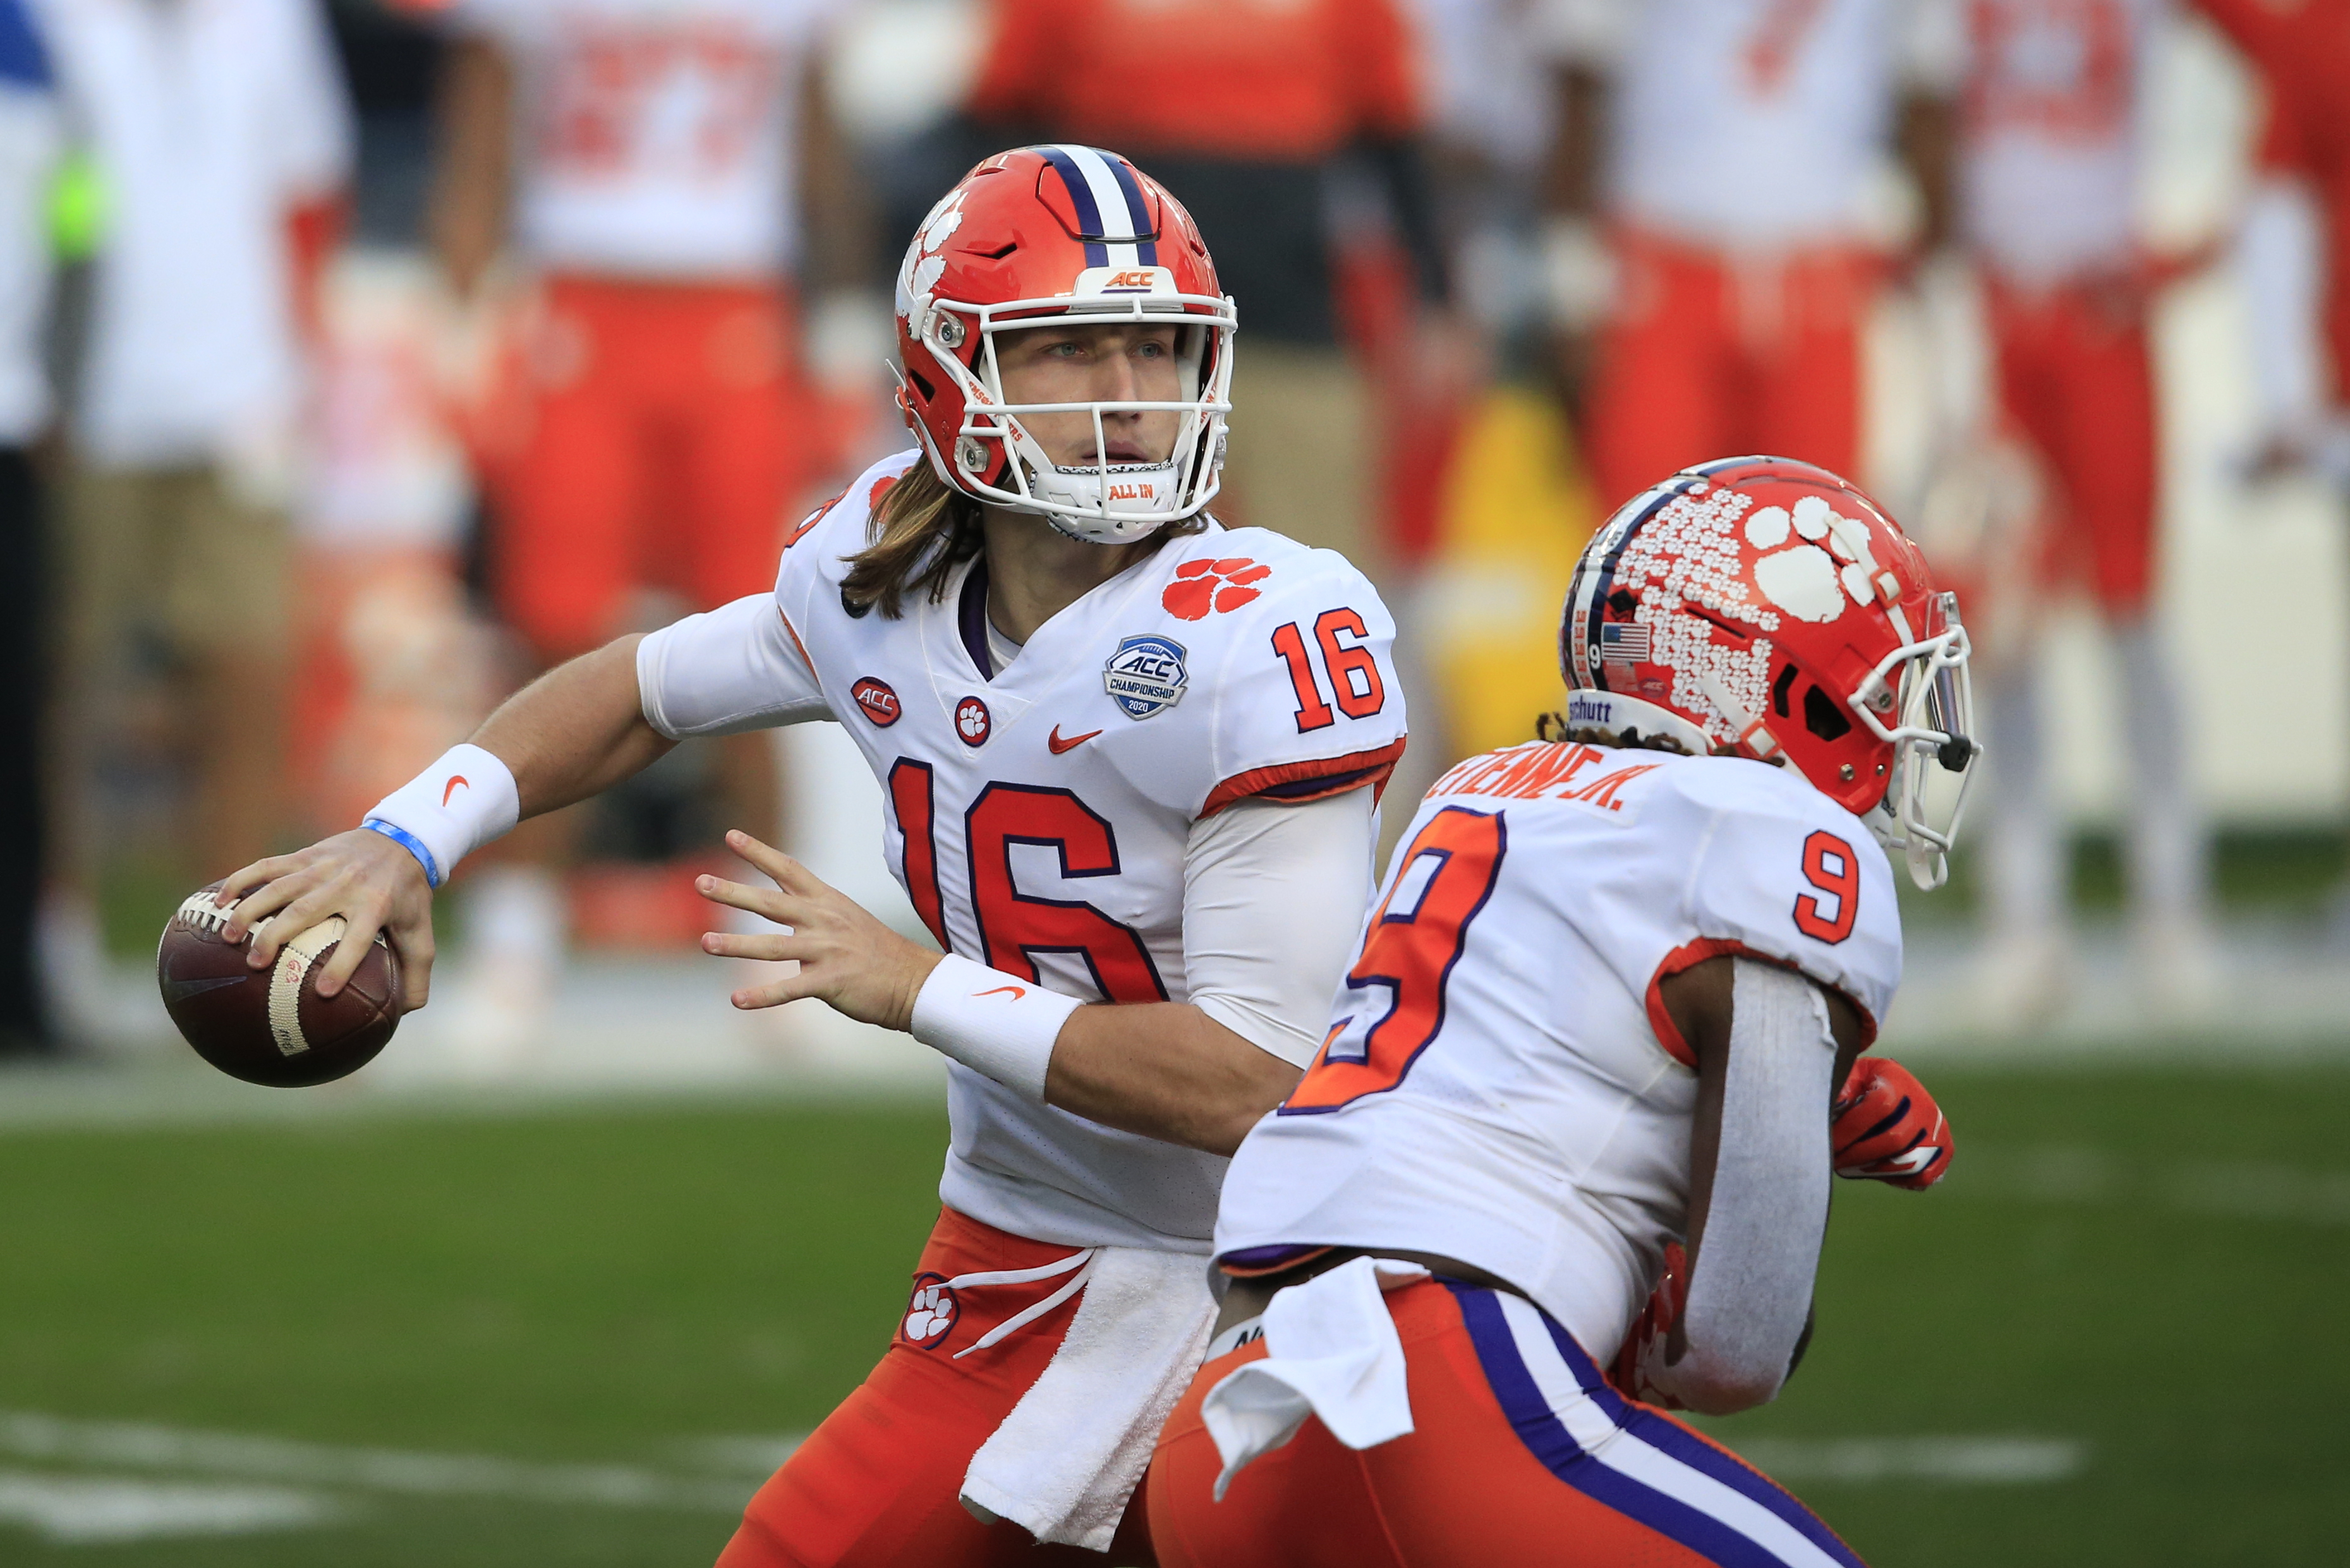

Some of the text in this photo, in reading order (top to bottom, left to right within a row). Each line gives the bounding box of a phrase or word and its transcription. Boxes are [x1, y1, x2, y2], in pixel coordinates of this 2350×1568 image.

[1105, 272, 1154, 287] ACC
[1108, 484, 1153, 500] ALL IN
[1120, 656, 1177, 678] ACC
[1589, 644, 1602, 670] 9
[1270, 606, 1385, 734] 16
[858, 688, 895, 711] ACC
[1110, 678, 1175, 699] CHAMPIONSHIP
[1129, 700, 1149, 718] 2020
[888, 756, 1171, 1004] 16
[1793, 829, 1859, 945] 9
[1277, 805, 1507, 1116] 9
